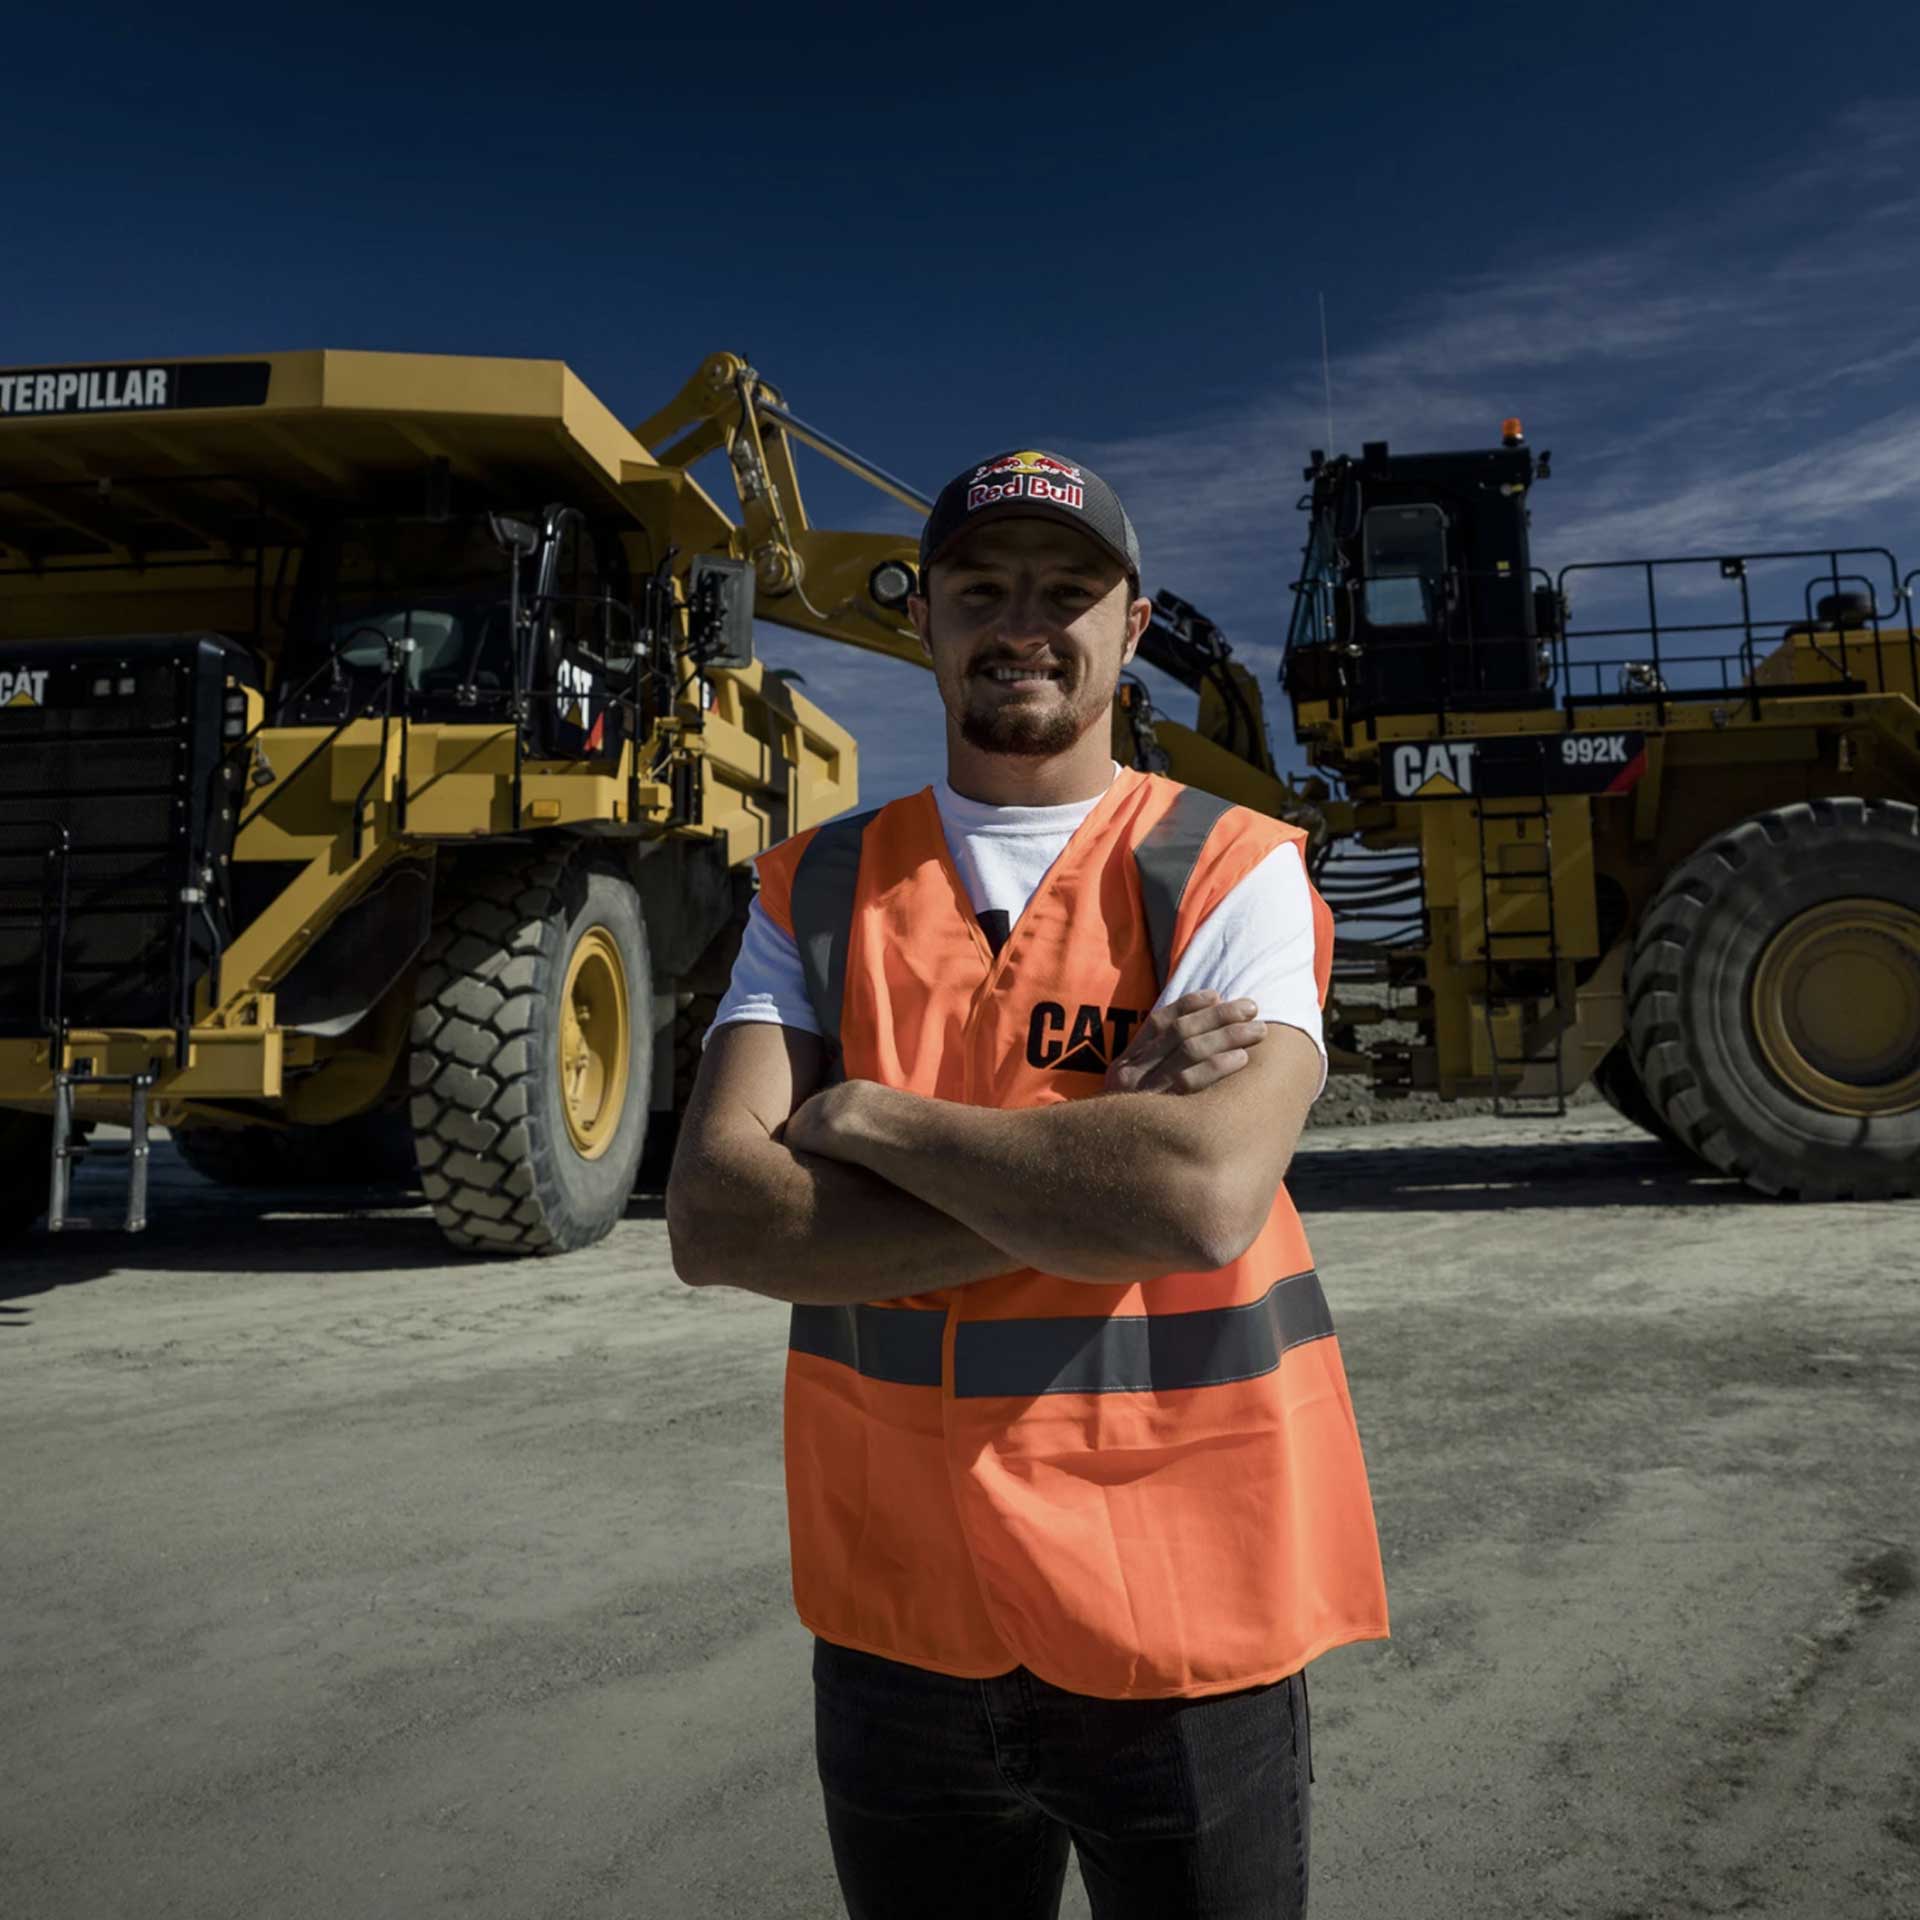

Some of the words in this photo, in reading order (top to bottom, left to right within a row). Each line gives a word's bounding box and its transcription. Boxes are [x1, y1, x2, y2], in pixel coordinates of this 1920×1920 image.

[0, 369, 167, 412] TERPILLAR
[968, 474, 1024, 511] Red
[1028, 476, 1084, 510] Bull
[0, 669, 49, 707] CAT
[1393, 742, 1476, 797] CAT
[1561, 735, 1628, 764] 992K
[1026, 1001, 1137, 1074] CAT
